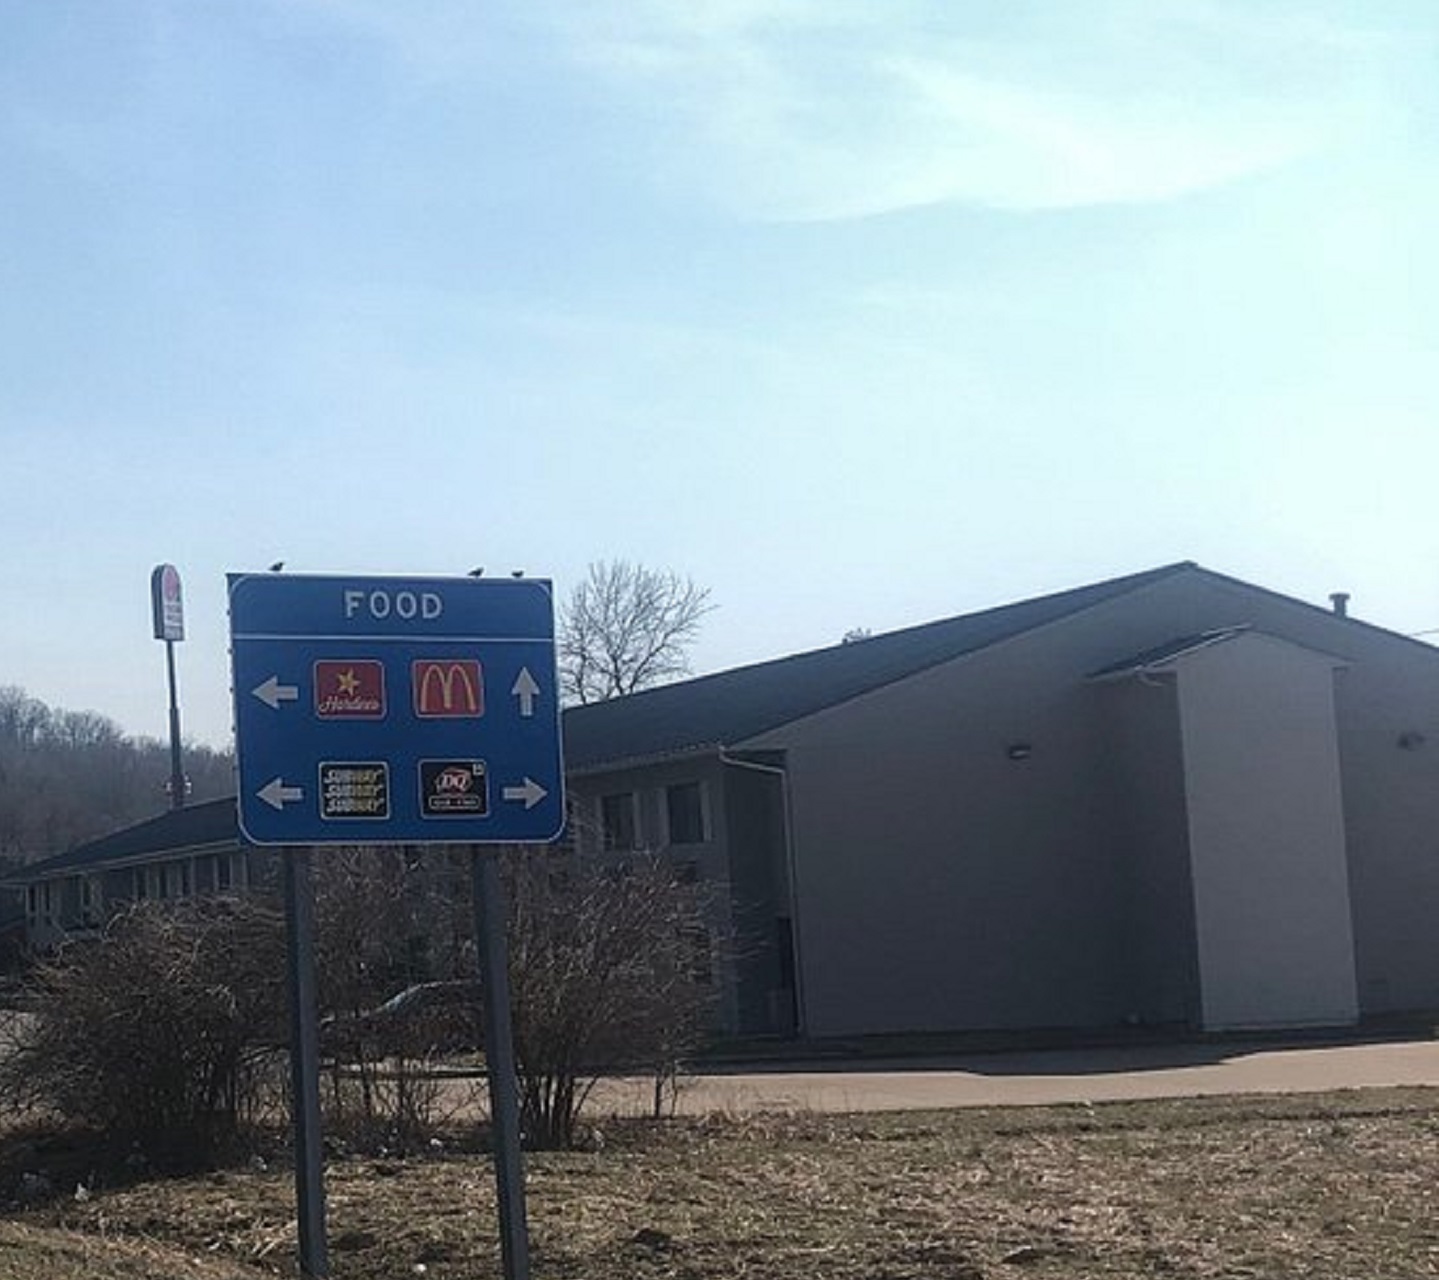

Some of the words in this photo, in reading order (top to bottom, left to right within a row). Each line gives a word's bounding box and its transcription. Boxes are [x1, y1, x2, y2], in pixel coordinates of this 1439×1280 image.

[344, 591, 443, 620] FOOD
[324, 769, 382, 784] SUBWAY
[441, 774, 466, 792] DQ
[325, 784, 384, 798] SUBWAY
[327, 798, 385, 813] SUBWAY
